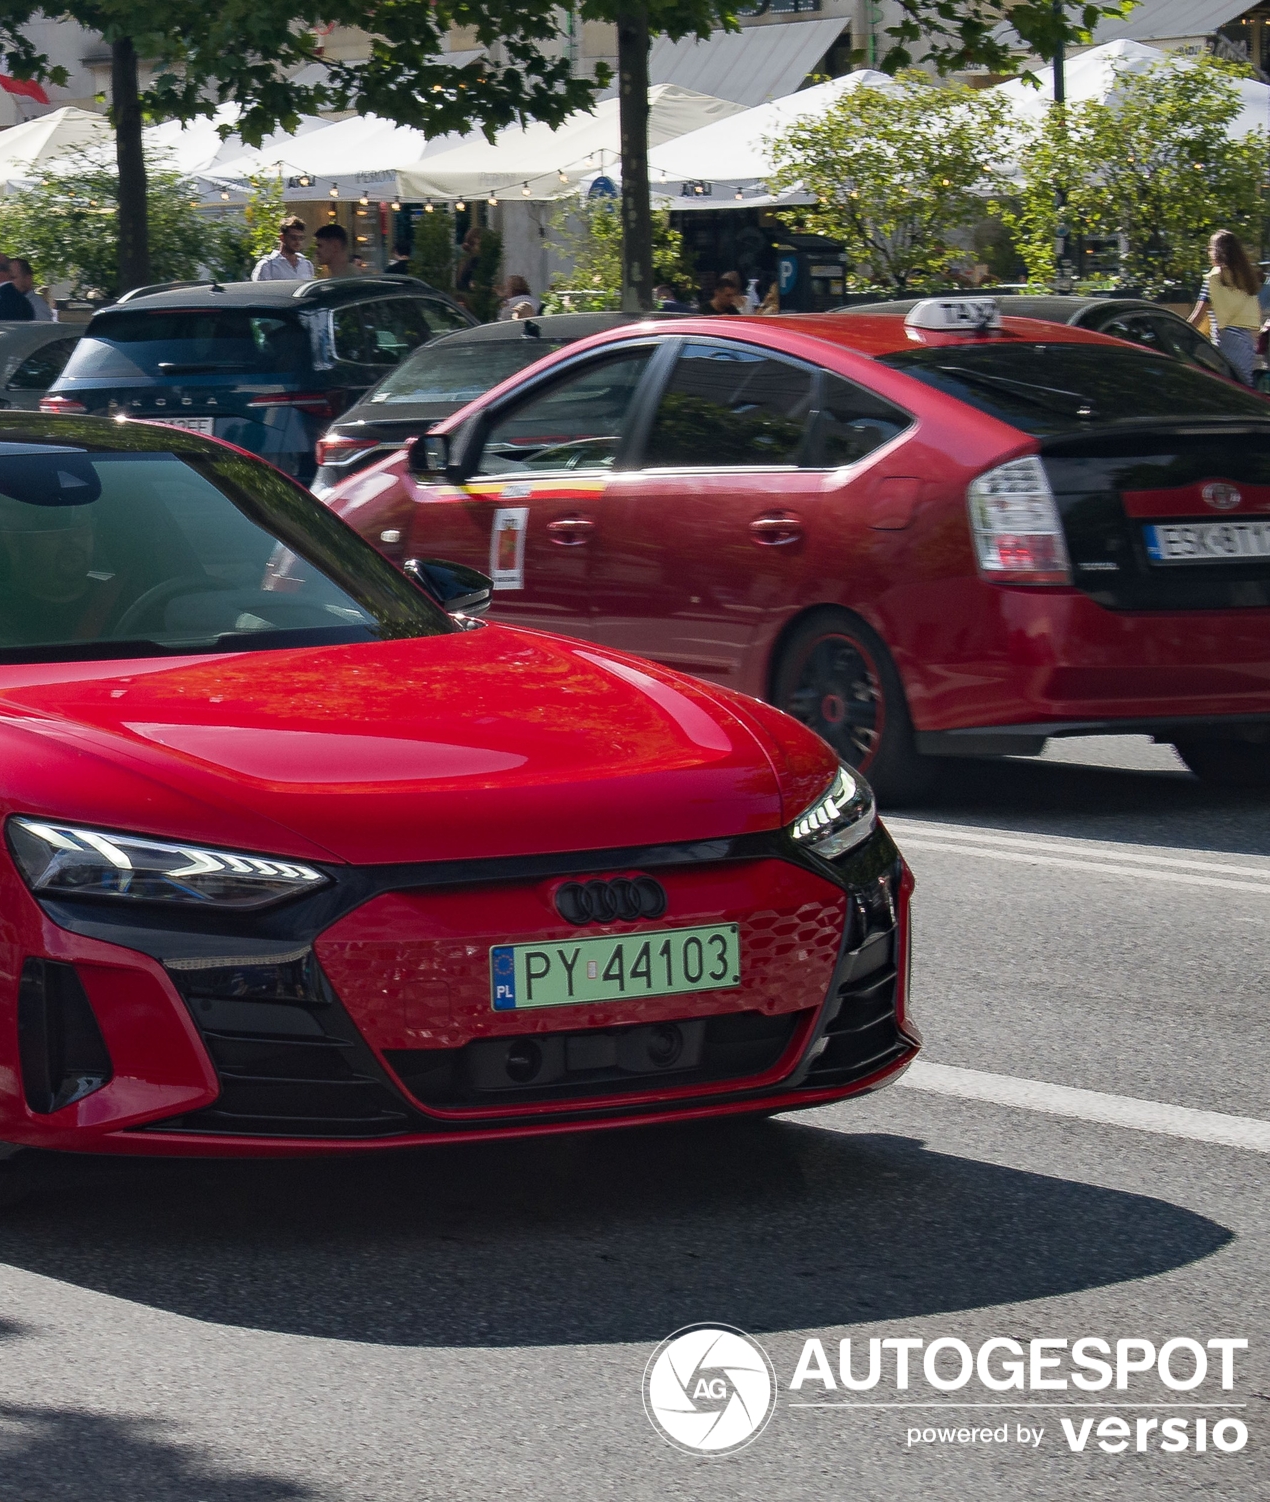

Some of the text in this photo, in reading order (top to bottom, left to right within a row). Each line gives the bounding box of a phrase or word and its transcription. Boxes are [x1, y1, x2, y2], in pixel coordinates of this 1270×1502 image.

[939, 301, 996, 325] TAXI
[525, 933, 728, 1000] PY 44103
[496, 985, 513, 999] PL
